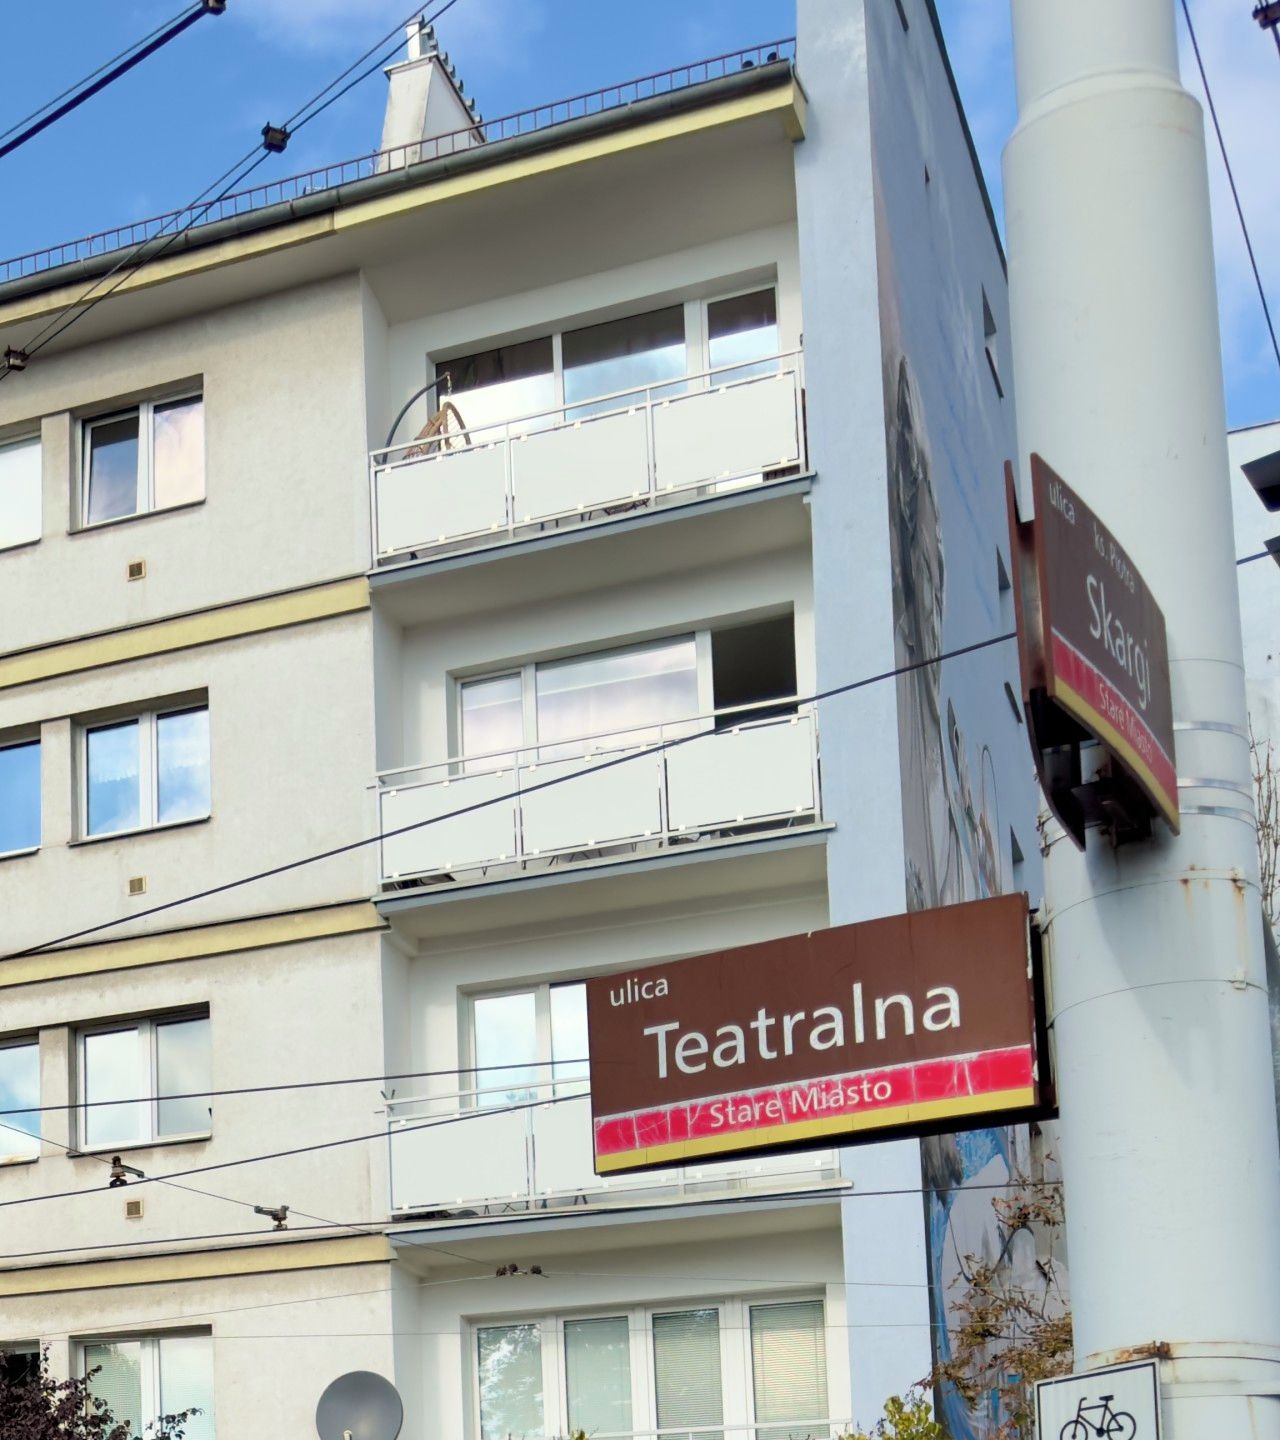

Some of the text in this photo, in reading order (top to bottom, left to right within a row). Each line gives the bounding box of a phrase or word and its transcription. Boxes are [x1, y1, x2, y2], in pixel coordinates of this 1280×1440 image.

[1049, 482, 1075, 525] ulica
[1086, 574, 1151, 711] Skargi
[1099, 683, 1124, 730] Stare
[609, 976, 669, 1007] ulica
[643, 981, 961, 1078] Teatralna
[709, 1080, 892, 1128] Stare Miasto
